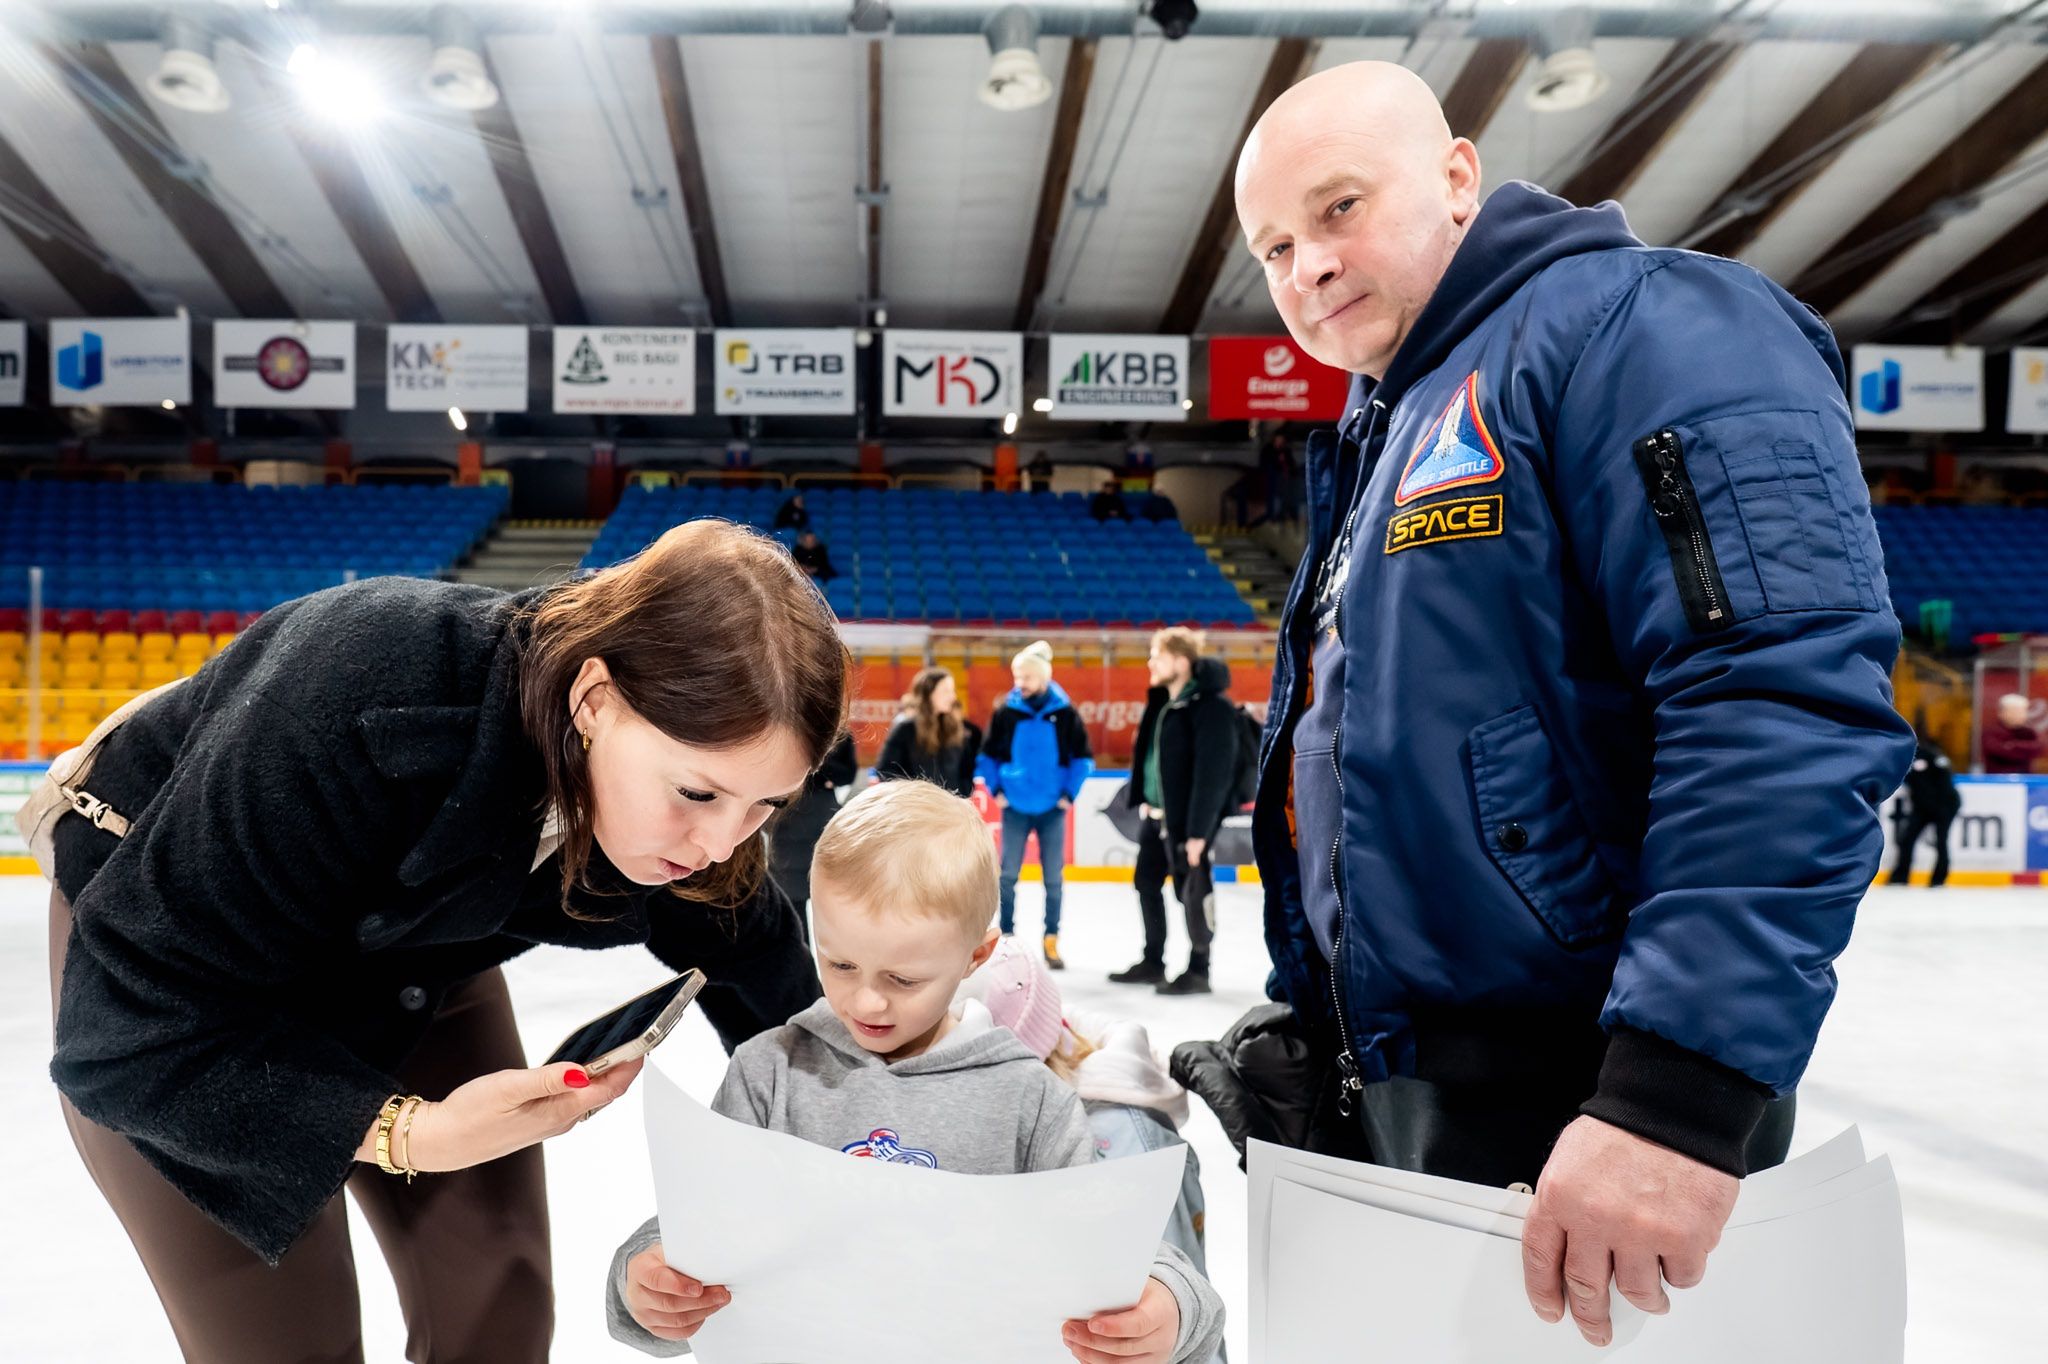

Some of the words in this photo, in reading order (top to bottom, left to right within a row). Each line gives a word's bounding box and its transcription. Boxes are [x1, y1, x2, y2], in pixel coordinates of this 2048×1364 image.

[768, 355, 843, 374] TRB
[1095, 352, 1178, 385] KBB
[395, 374, 446, 390] TECH
[896, 355, 1001, 406] MKD
[1064, 390, 1174, 404] ENGINEERING
[1439, 458, 1490, 480] SHUTTLE
[1392, 504, 1491, 544] SPACE
